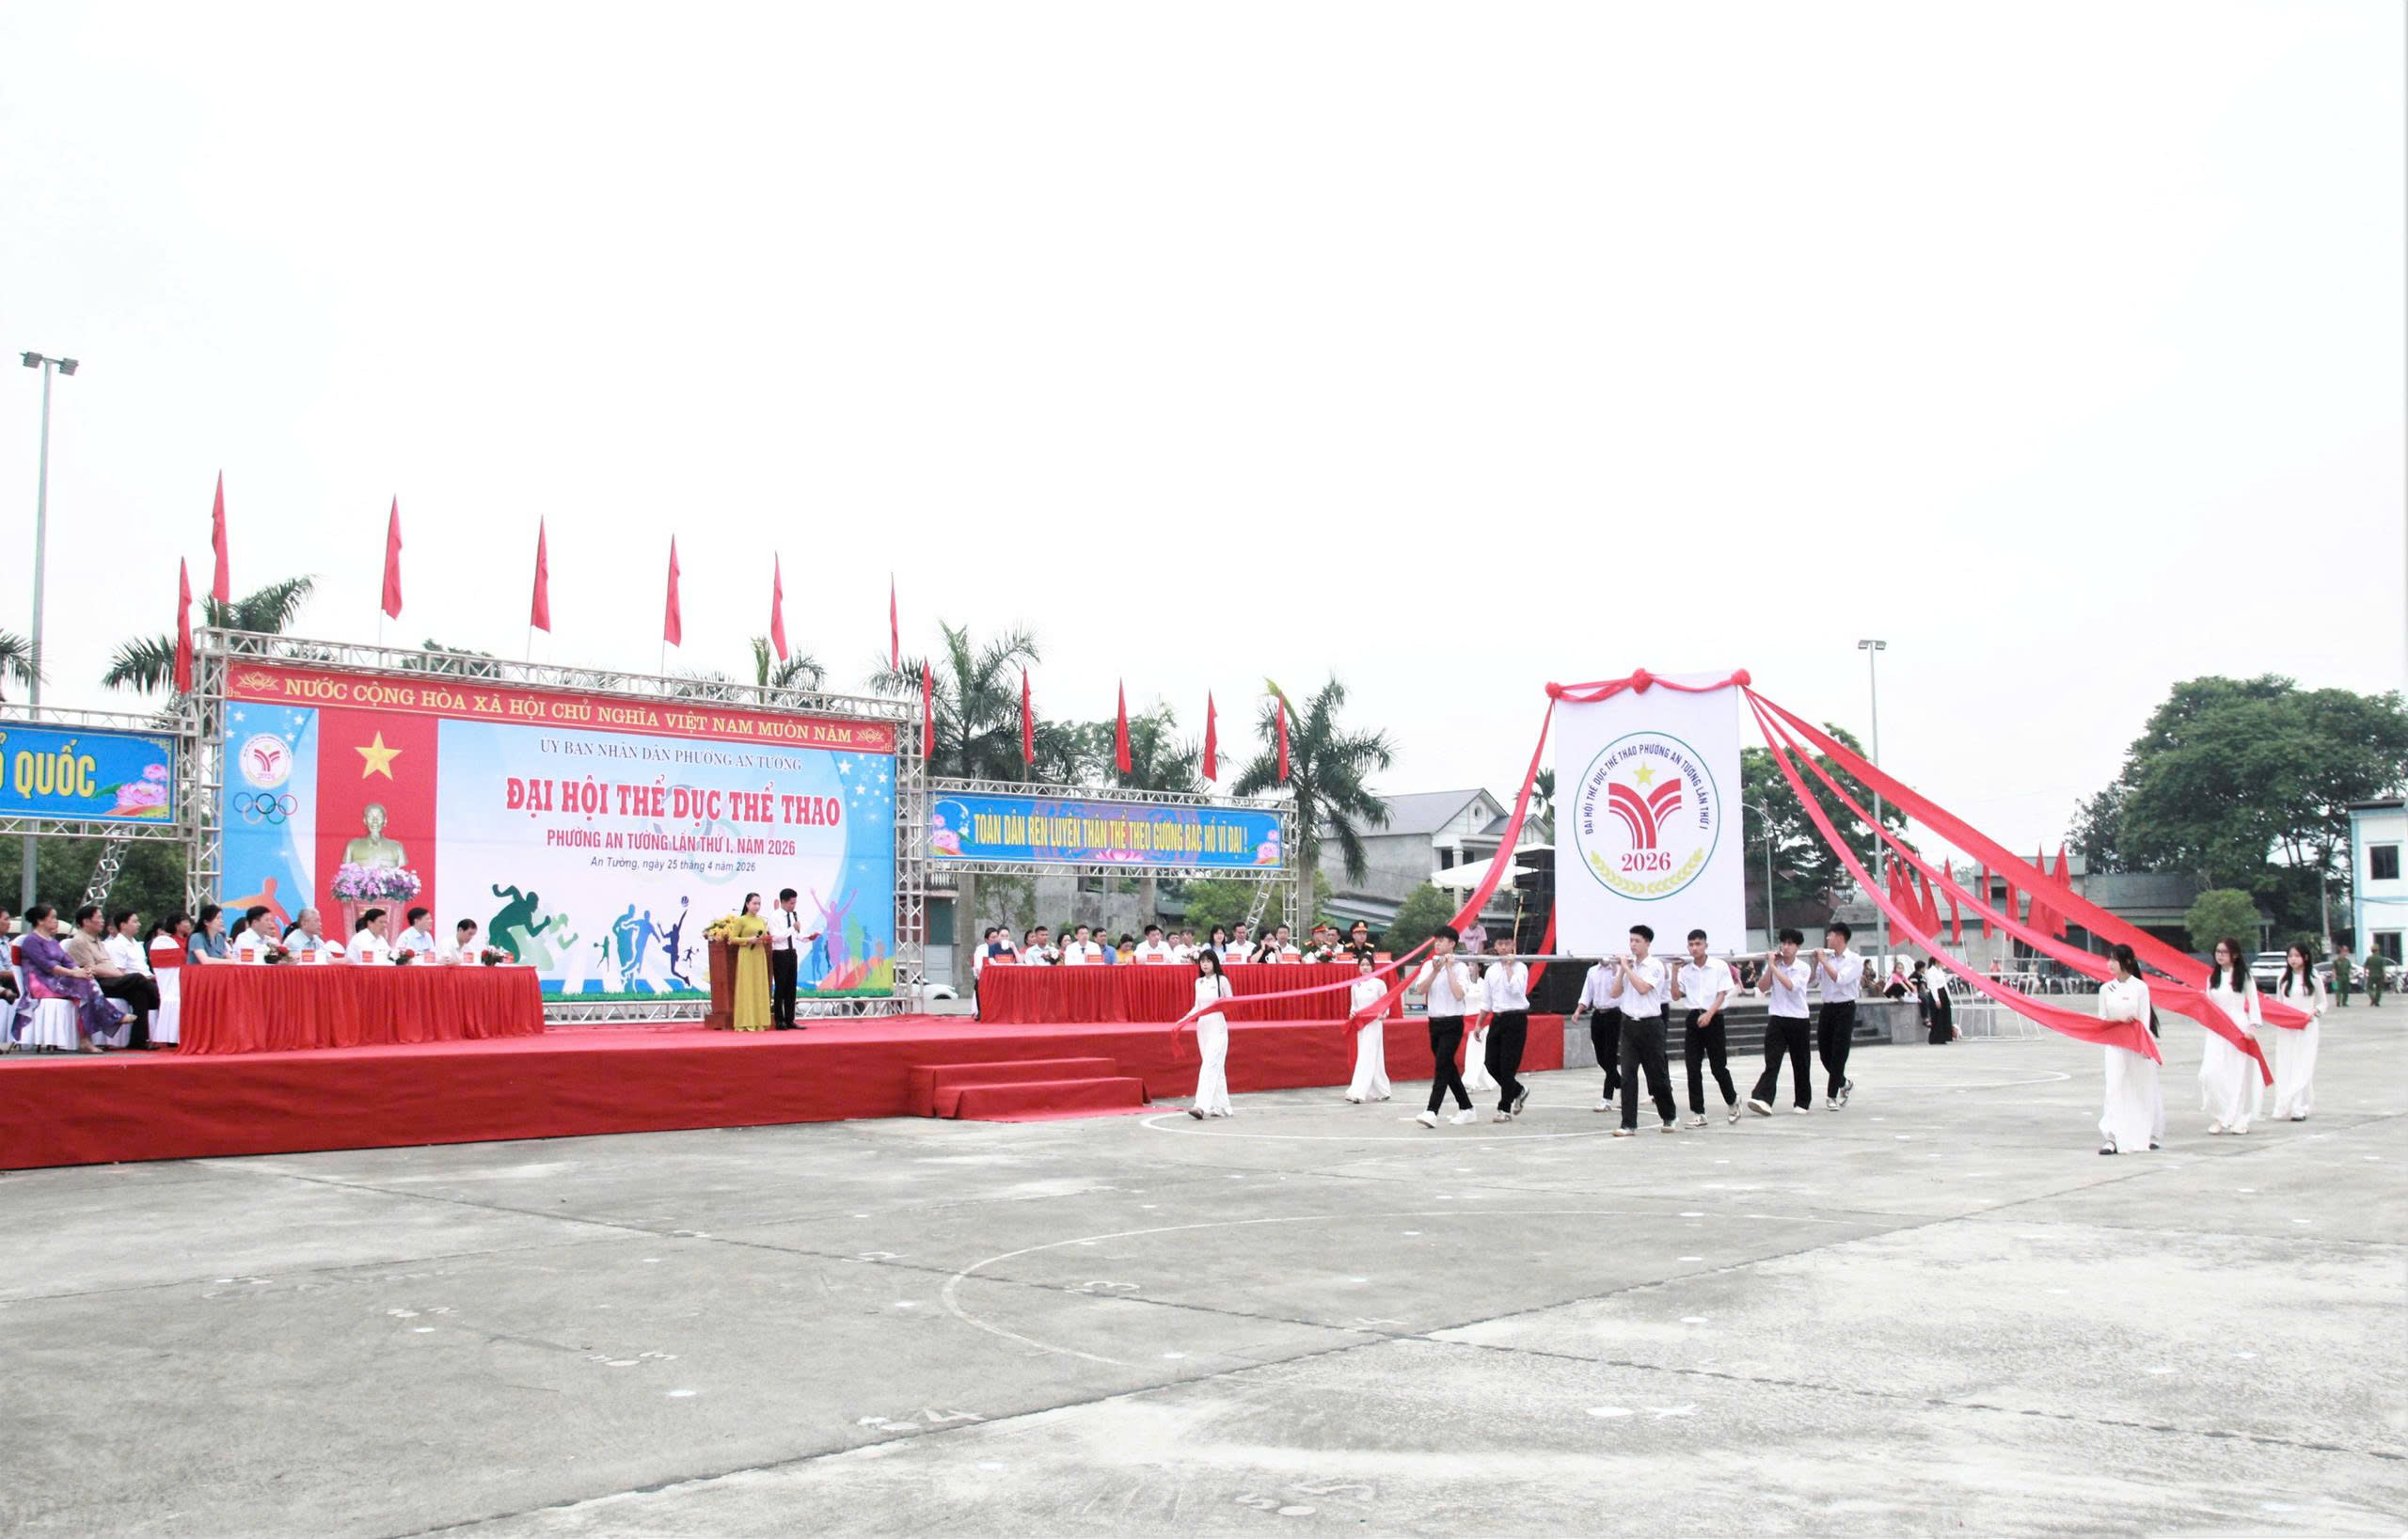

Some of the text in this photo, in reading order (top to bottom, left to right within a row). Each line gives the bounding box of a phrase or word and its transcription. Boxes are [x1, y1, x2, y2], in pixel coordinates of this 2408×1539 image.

[284, 677, 851, 742] NƯỚC CỘNG HÒA XÃ HỘI CHỦ NGHĨA VIỆT NAM MUÔN NĂM
[564, 740, 594, 755] BAN
[598, 741, 638, 758] NHÂN
[642, 743, 671, 761] DÂN
[736, 754, 753, 767] AN
[1618, 745, 1638, 760] THAO
[1670, 752, 1683, 765] AN
[15, 738, 96, 800] QUỐC
[506, 774, 840, 828] ĐẠI HỘI THỂ DỤC THỂ THAO
[547, 826, 601, 848] PHƯỜNG
[605, 833, 623, 849] AN
[627, 830, 668, 850] TƯỜNG
[673, 830, 696, 851] LẦN
[700, 833, 723, 853] THỨ
[737, 835, 764, 854] NĂM
[768, 839, 796, 856] 2026
[974, 807, 1001, 845] TOÀN
[1004, 808, 1025, 845] DÂN
[1028, 810, 1048, 846] RÈN
[1051, 812, 1080, 854] LUYỆN
[1083, 813, 1107, 849] THÂN
[1109, 808, 1127, 849] THỂ
[1129, 820, 1150, 850] THEO
[1153, 819, 1183, 851] GƯƠNG
[1185, 817, 1202, 852] BÁC
[1244, 827, 1248, 853] !
[591, 856, 604, 867] An
[642, 858, 665, 871] ngày
[667, 859, 677, 869] 25
[680, 859, 705, 873] tháng
[707, 861, 713, 869] 4
[715, 861, 734, 871] năm
[737, 861, 756, 872] 2026
[1622, 851, 1671, 871] 2026
